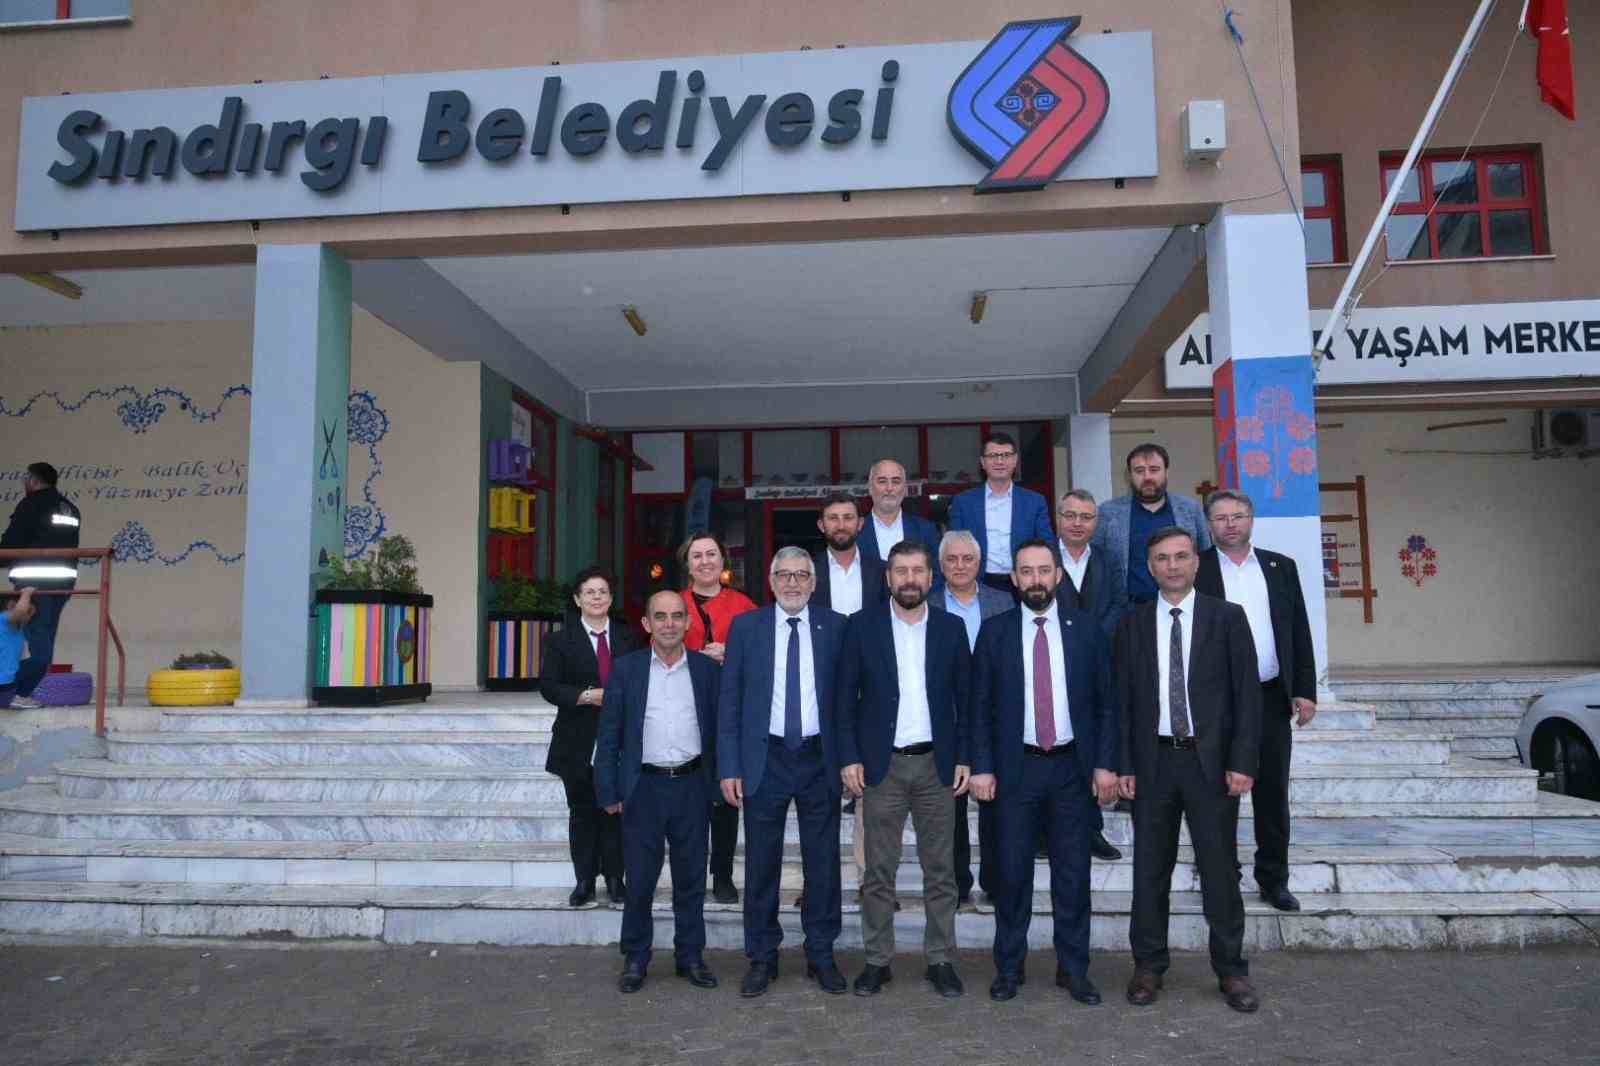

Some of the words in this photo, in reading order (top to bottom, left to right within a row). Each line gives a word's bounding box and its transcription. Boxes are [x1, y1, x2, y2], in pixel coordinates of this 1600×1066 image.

[48, 96, 388, 192] Sındırgı
[417, 59, 900, 171] Belediyesi
[1346, 325, 1470, 367] YAŞAM
[1483, 320, 1600, 355] MERKE
[196, 480, 248, 497] Zorl
